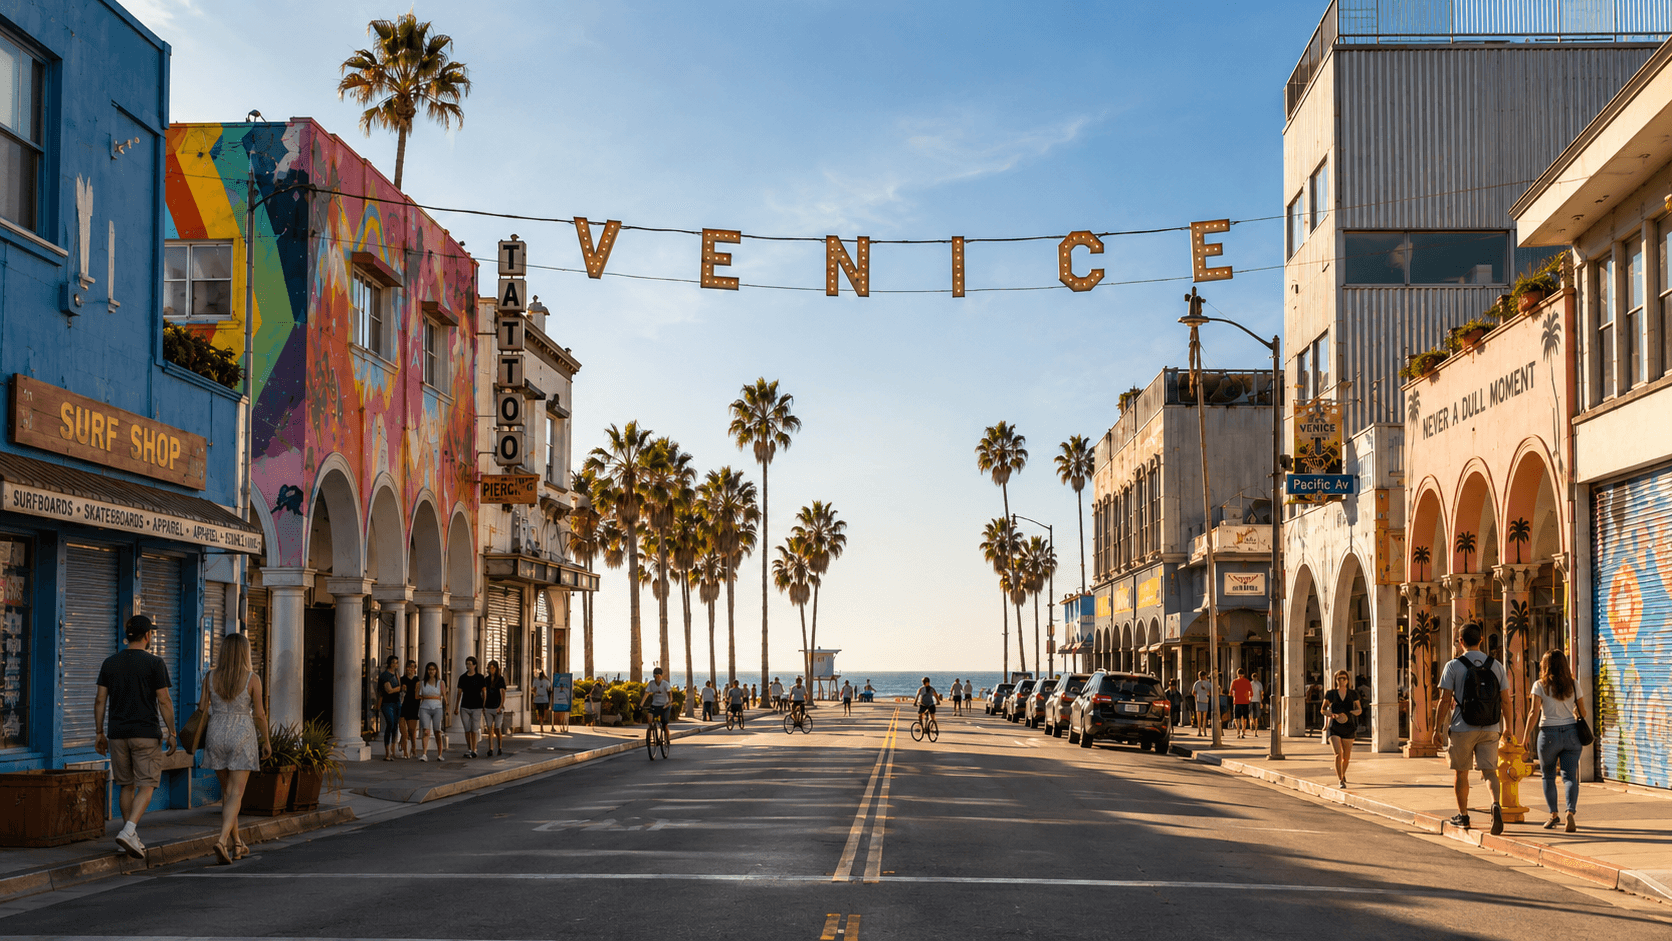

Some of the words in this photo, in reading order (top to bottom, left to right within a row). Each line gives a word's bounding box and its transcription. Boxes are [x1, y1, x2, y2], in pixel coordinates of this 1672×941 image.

[573, 216, 1233, 297] VENICE
[500, 244, 520, 461] TATTOO
[1299, 423, 1336, 433] VENICE
[1423, 406, 1449, 440] NEVER
[1452, 402, 1459, 426] A
[1462, 388, 1486, 421] DULL
[1490, 360, 1536, 408] MOMENT
[59, 401, 119, 452] SURF
[130, 424, 181, 470] SHOP
[13, 489, 73, 516] SURFBOARDS
[1293, 478, 1331, 490] Pacific
[1335, 479, 1349, 490] Av
